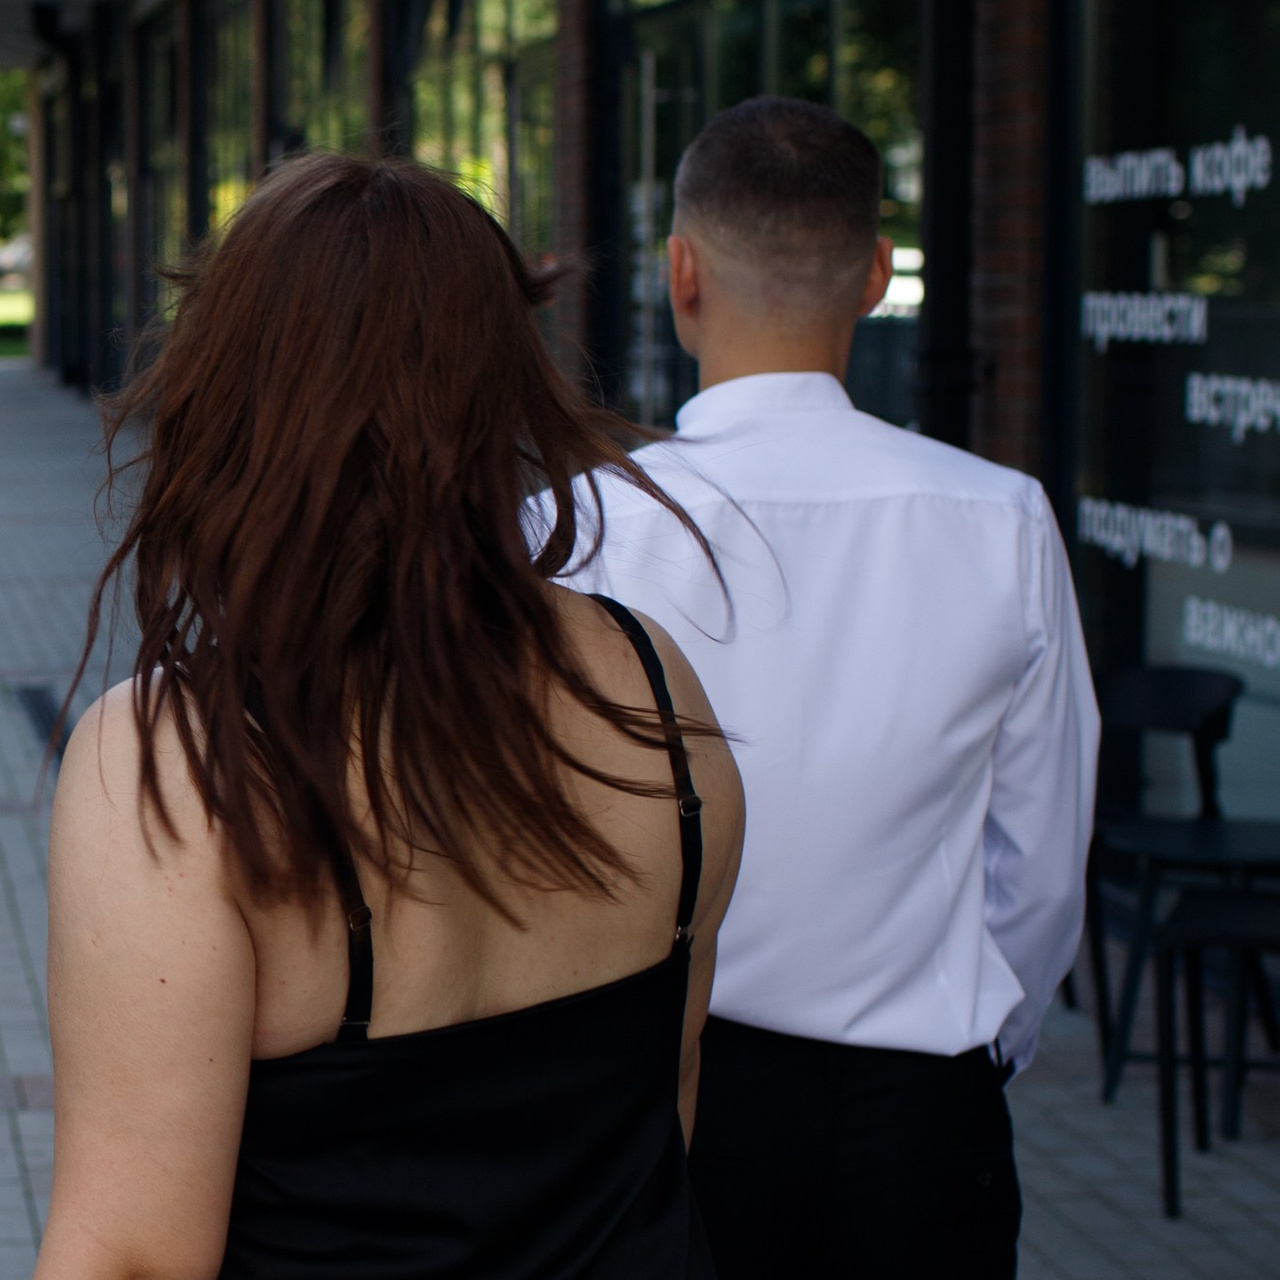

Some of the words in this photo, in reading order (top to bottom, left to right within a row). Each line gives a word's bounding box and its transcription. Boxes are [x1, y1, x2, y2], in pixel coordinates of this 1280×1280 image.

[1084, 147, 1185, 204] выпить
[1190, 124, 1271, 208] кофе
[1082, 292, 1207, 353] провести
[1078, 497, 1206, 568] подумать
